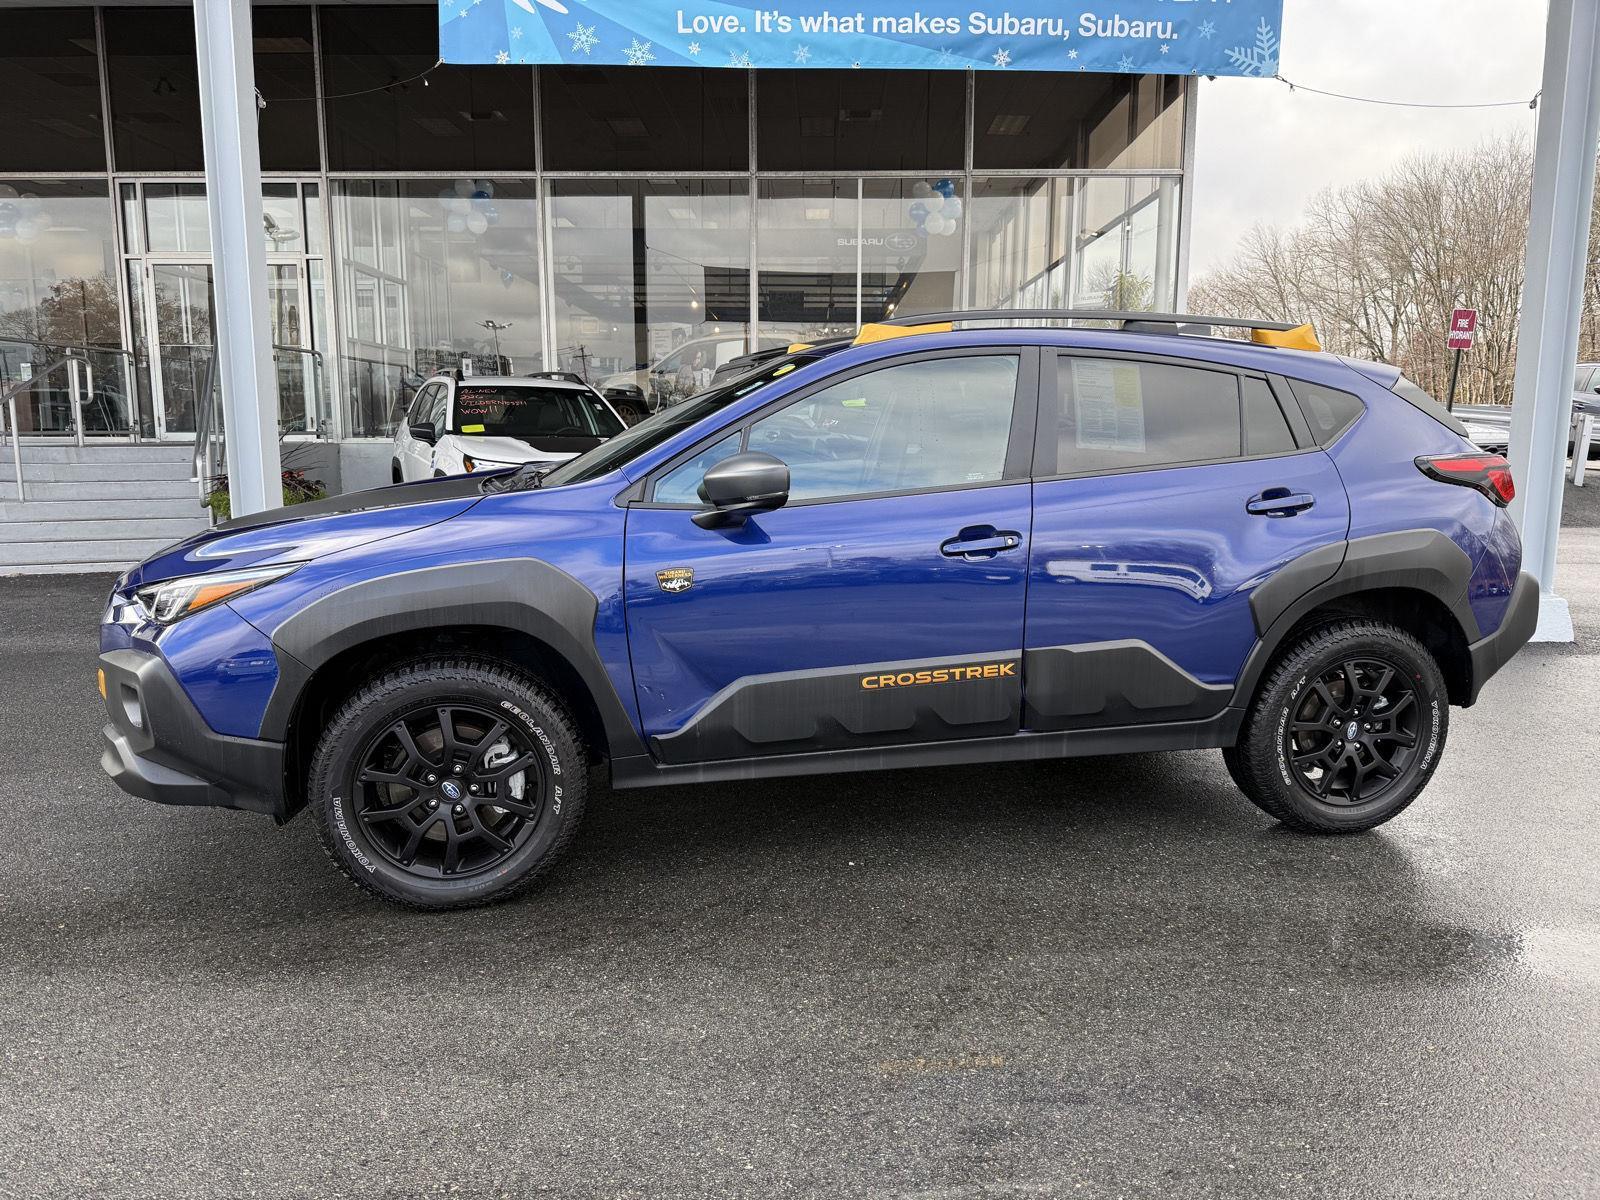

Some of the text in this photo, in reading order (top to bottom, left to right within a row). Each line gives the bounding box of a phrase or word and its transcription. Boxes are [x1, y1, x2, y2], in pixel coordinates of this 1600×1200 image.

[677, 10, 746, 34] Love.
[800, 12, 864, 33] what
[873, 12, 960, 34] makes
[968, 12, 1070, 40] Subaru,
[1078, 13, 1178, 39] Subaru.
[837, 238, 884, 246] SUBARU
[1449, 330, 1474, 340] HYDRANT
[1457, 318, 1469, 328] FIRE
[861, 662, 1016, 690] CROSSTREK
[500, 700, 561, 776] GEOLANDAR
[1420, 700, 1440, 770] YOKOHAMA
[332, 796, 377, 873] YOKOHAMA
